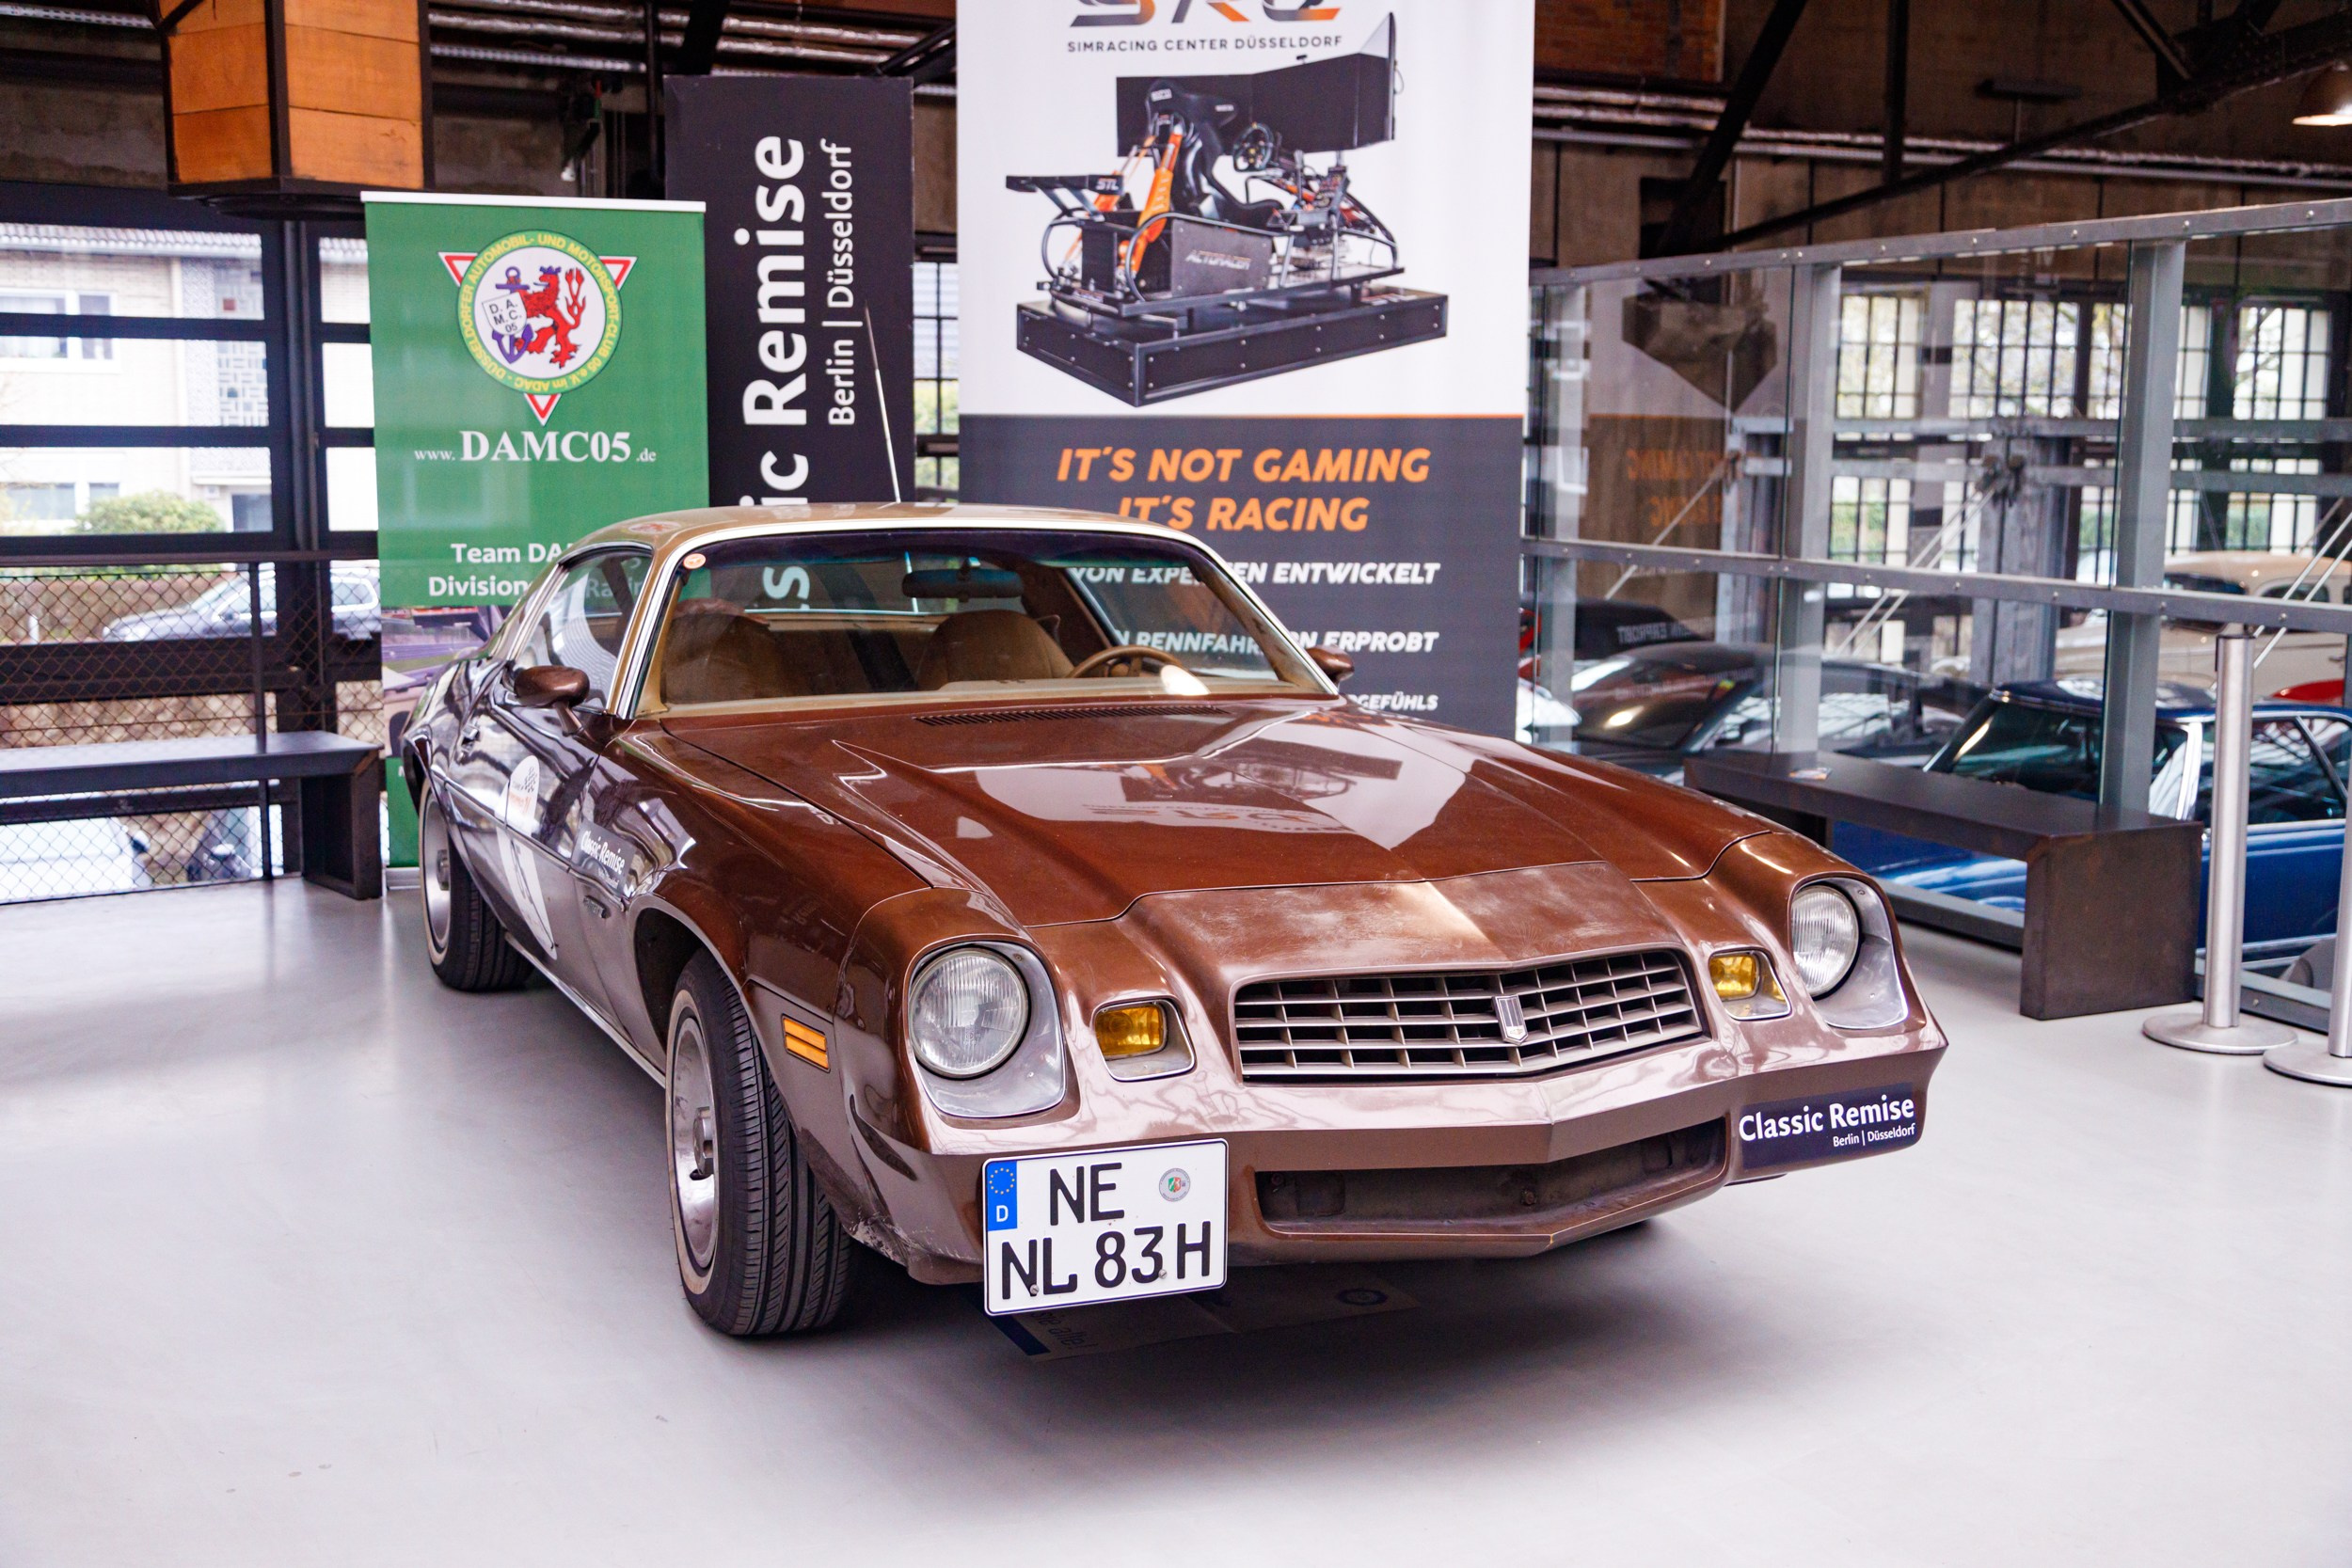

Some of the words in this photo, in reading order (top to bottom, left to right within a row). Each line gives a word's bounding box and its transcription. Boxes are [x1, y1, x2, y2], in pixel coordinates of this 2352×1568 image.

[1068, 40, 1157, 52] SIMRACING
[1165, 39, 1228, 50] CENTER
[1235, 35, 1343, 50] DÜSSELDORF
[820, 138, 854, 309] Düsseldorf
[537, 233, 566, 248] UND
[734, 135, 808, 426] Remise
[514, 378, 549, 392] ADAC
[825, 339, 856, 426] Berlin
[414, 451, 455, 461] www.
[459, 431, 631, 463] DAMC05
[636, 448, 657, 462] .de
[1148, 448, 1243, 483] NOT
[1252, 448, 1431, 483] GAMING
[1206, 497, 1370, 531] RACING
[451, 543, 520, 563] Team
[1273, 562, 1440, 584] ENTWICKELT
[1323, 631, 1439, 653] ERPROBT
[580, 831, 601, 860] Classic
[598, 842, 626, 875] Remise
[1739, 1105, 1823, 1142] Classic
[1829, 1095, 1915, 1129] Remise
[1833, 1134, 1860, 1148] Berlin
[1867, 1123, 1915, 1142] Düsseldorf
[1050, 1163, 1124, 1226] NE
[996, 1205, 1009, 1222] D
[1002, 1237, 1078, 1300] NL
